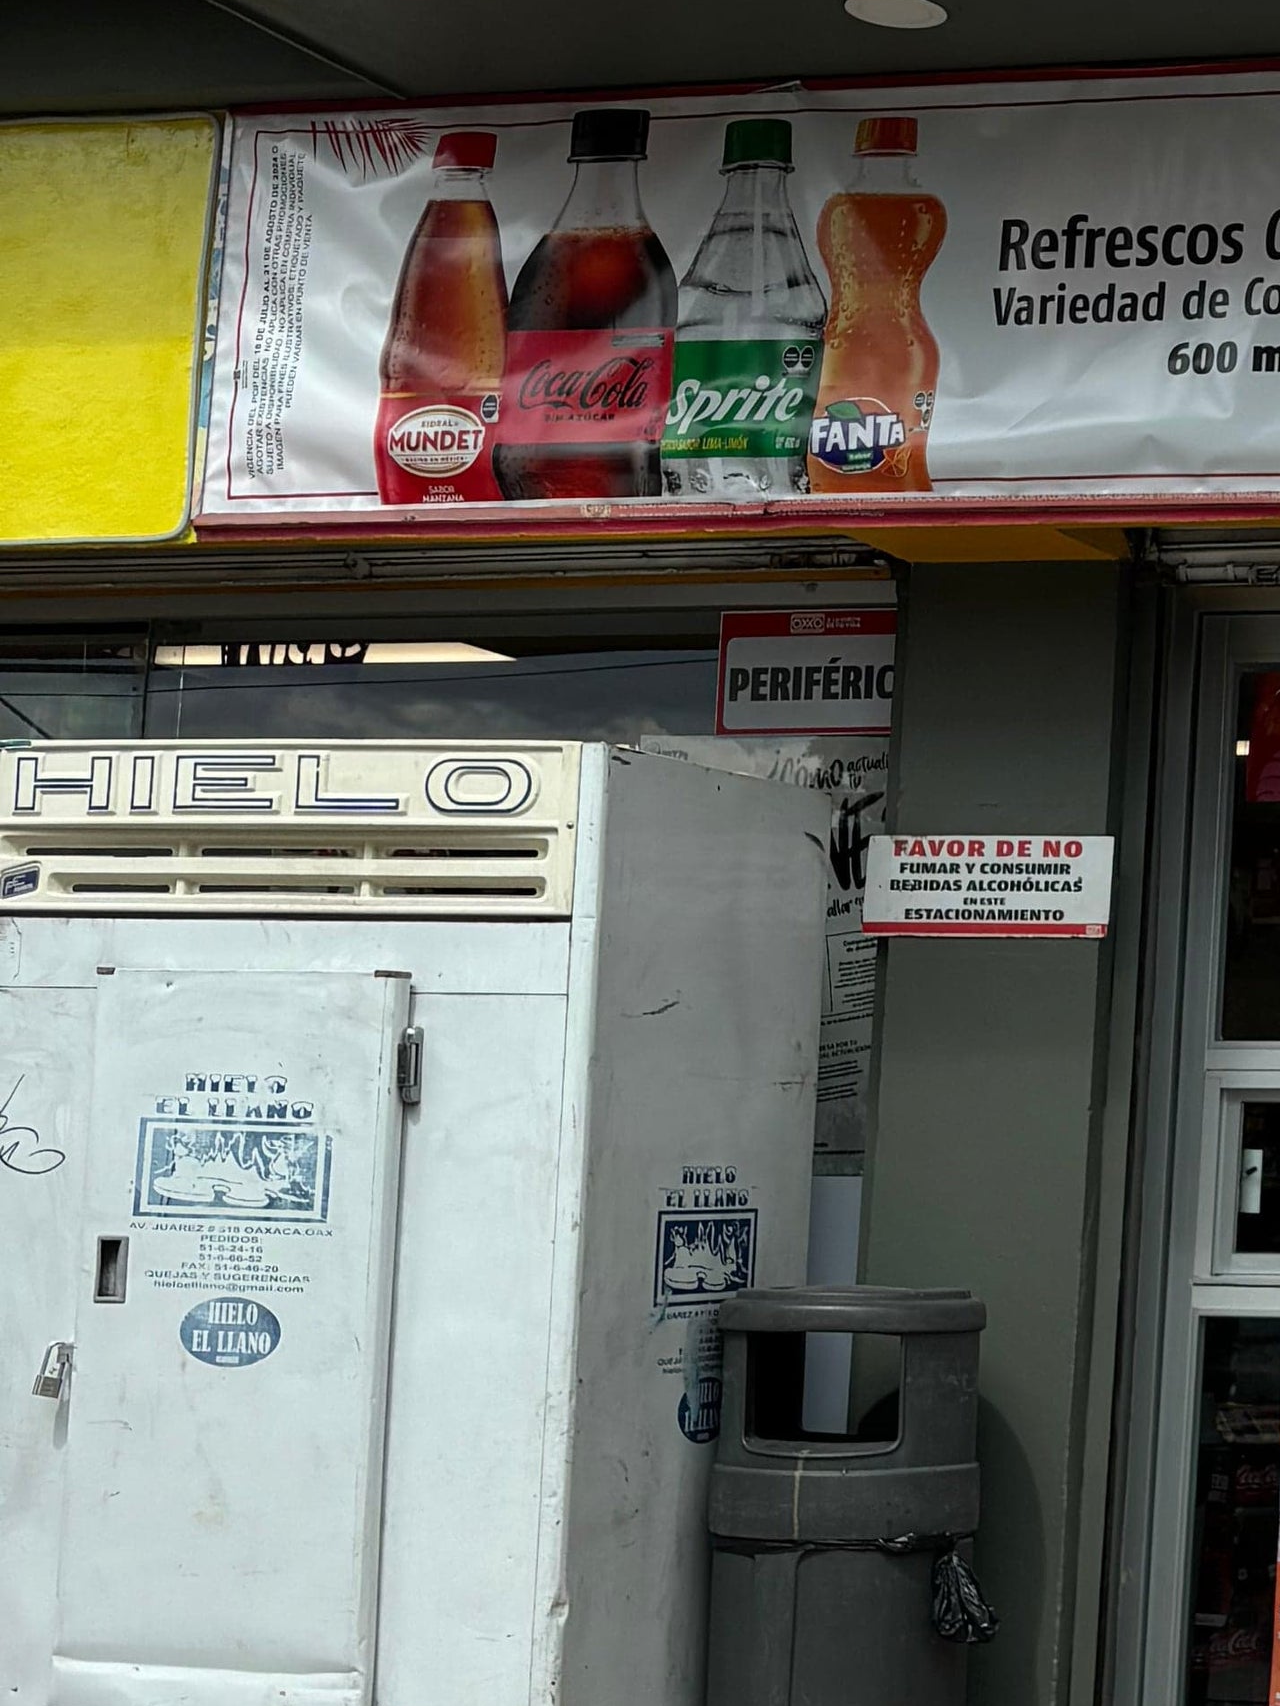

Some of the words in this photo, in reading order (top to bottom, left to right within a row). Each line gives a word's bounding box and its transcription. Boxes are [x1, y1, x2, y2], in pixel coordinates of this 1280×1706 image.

[998, 213, 1245, 272] Refrescos
[992, 280, 1166, 327] Variedad
[1182, 280, 1230, 320] de
[1166, 340, 1238, 375] 600
[246, 429, 255, 479] VIGENCIA
[260, 295, 270, 325] JULIO
[665, 374, 804, 435] Sprite
[389, 428, 483, 452] MUNDET
[810, 413, 905, 454] FANTA
[15, 754, 533, 812] HIELO
[893, 839, 986, 858] FAVOR
[996, 840, 1032, 858] DE
[1042, 840, 1083, 858] NO
[899, 862, 960, 875] FUMAR
[965, 862, 977, 875] Y
[979, 862, 1071, 876] CONSUMIR
[890, 879, 962, 892] BEBIDAS
[966, 877, 1083, 893] ALCOHÓLICAS
[963, 897, 978, 906] EN
[980, 897, 1006, 906] ESTE
[904, 908, 1065, 921] ESTACIONAMIENTO
[185, 1073, 288, 1094] HIELO
[144, 1270, 198, 1280] QUEJAS
[213, 1273, 311, 1283] SUGERENCIAS
[208, 1301, 258, 1325] HIELO
[191, 1329, 211, 1352] EL
[217, 1330, 271, 1355] LLANO
